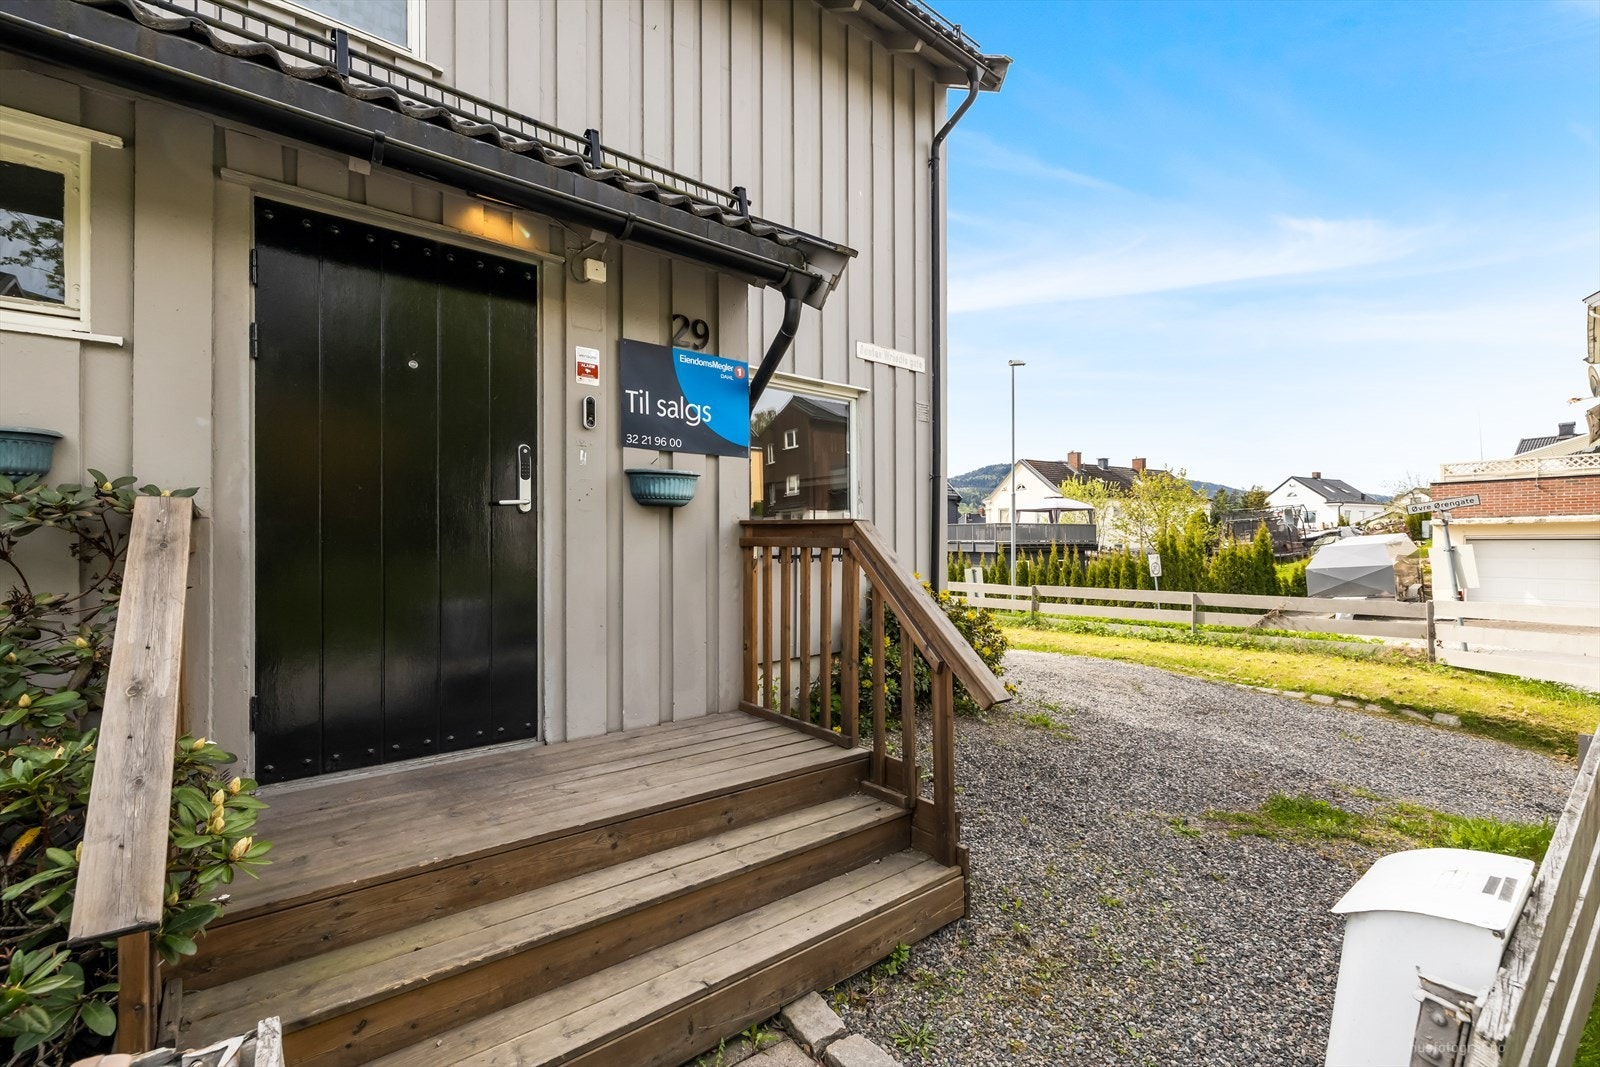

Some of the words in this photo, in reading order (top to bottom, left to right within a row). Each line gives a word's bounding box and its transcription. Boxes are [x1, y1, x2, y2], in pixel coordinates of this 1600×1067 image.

[672, 313, 710, 350] 29
[679, 354, 734, 373] EiendomsMegler
[720, 373, 734, 381] DAHL
[625, 389, 650, 415] Til
[656, 395, 712, 427] salgs
[626, 433, 639, 444] 32
[641, 435, 652, 445] 21
[654, 436, 667, 447] 96
[669, 438, 682, 448] 00
[1411, 504, 1432, 513] Øvre
[1433, 497, 1475, 509] Ørengate
